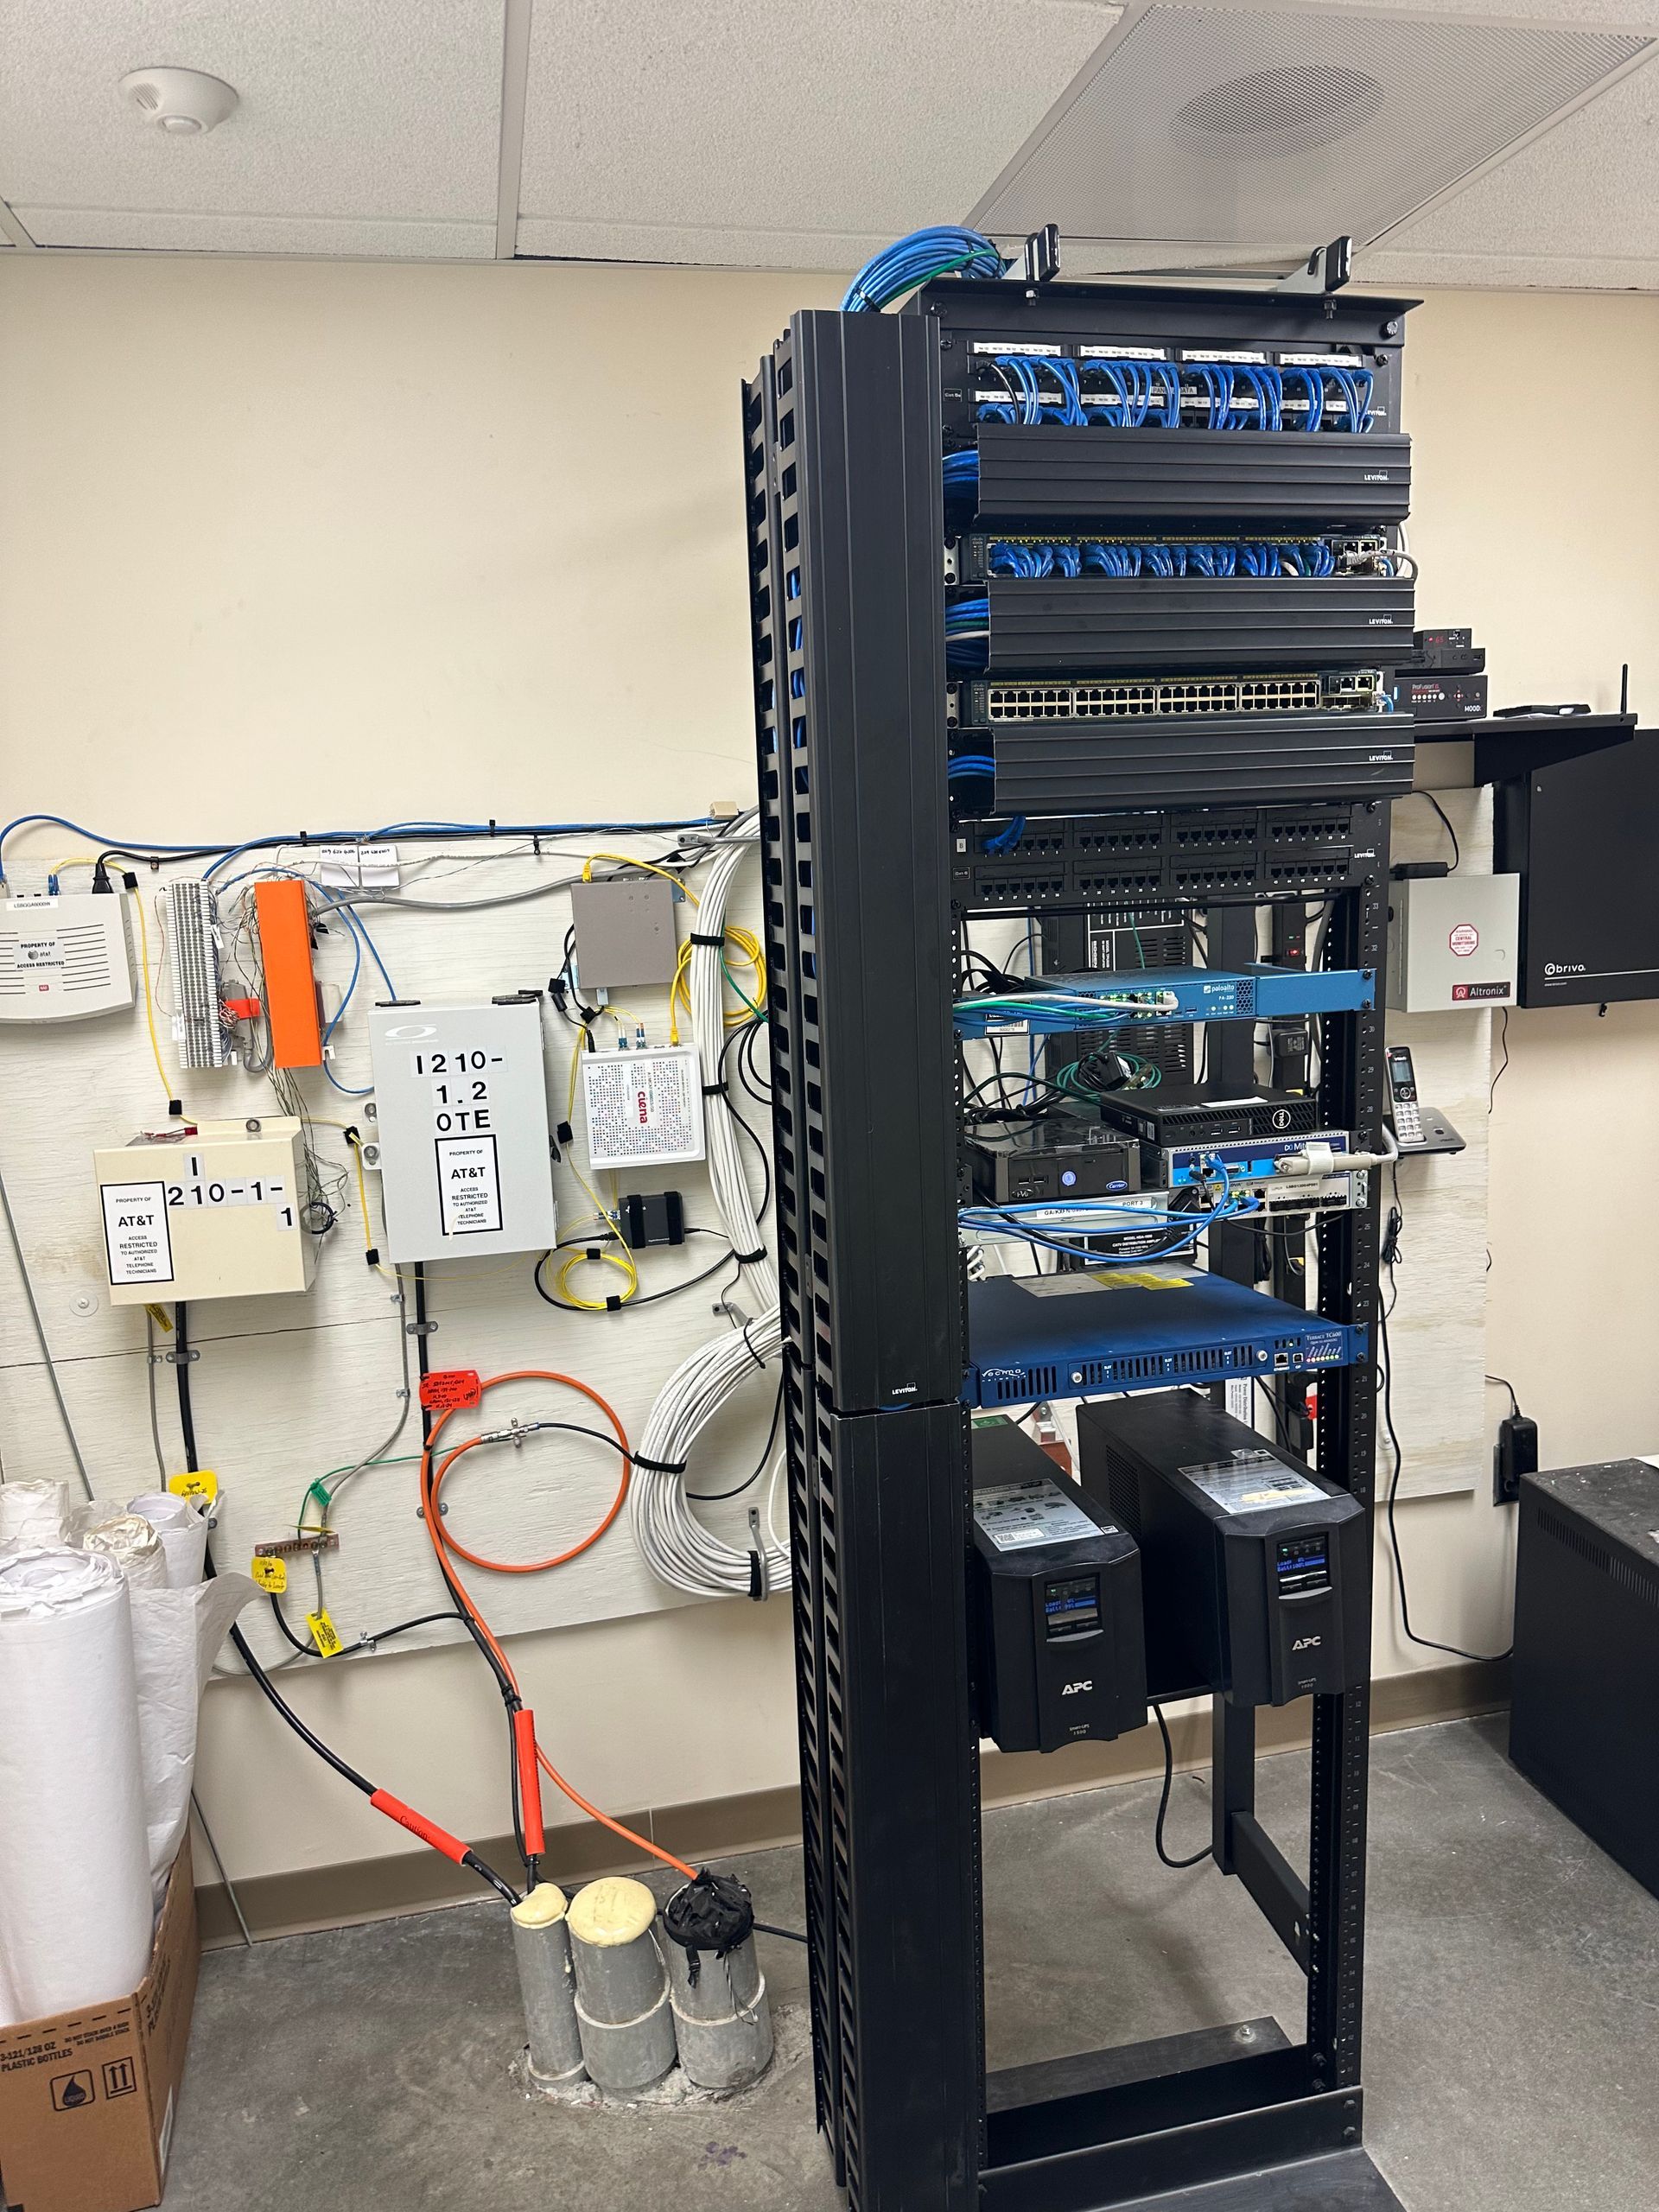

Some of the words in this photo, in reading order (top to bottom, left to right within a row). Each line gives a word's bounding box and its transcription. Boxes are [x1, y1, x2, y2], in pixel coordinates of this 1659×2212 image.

[1556, 964, 1585, 974] brivo
[1211, 984, 1235, 994] paloalto
[1470, 986, 1504, 996] Altronix
[638, 1091, 648, 1124] ciena
[451, 1166, 486, 1179] AT&T
[168, 1181, 283, 1206] 210-1-
[451, 1192, 488, 1201] RESTRICTED
[118, 1214, 155, 1228] AT&T
[281, 1207, 293, 1227] 1
[119, 1241, 158, 1249] RESTRICTED
[892, 1386, 917, 1395] LEVITON
[1292, 1636, 1321, 1651] APC
[1061, 1680, 1093, 1696] APC
[44, 2041, 56, 2051] OZ
[1, 2057, 35, 2072] PLASTIC
[37, 2048, 73, 2064] BOTTLES
